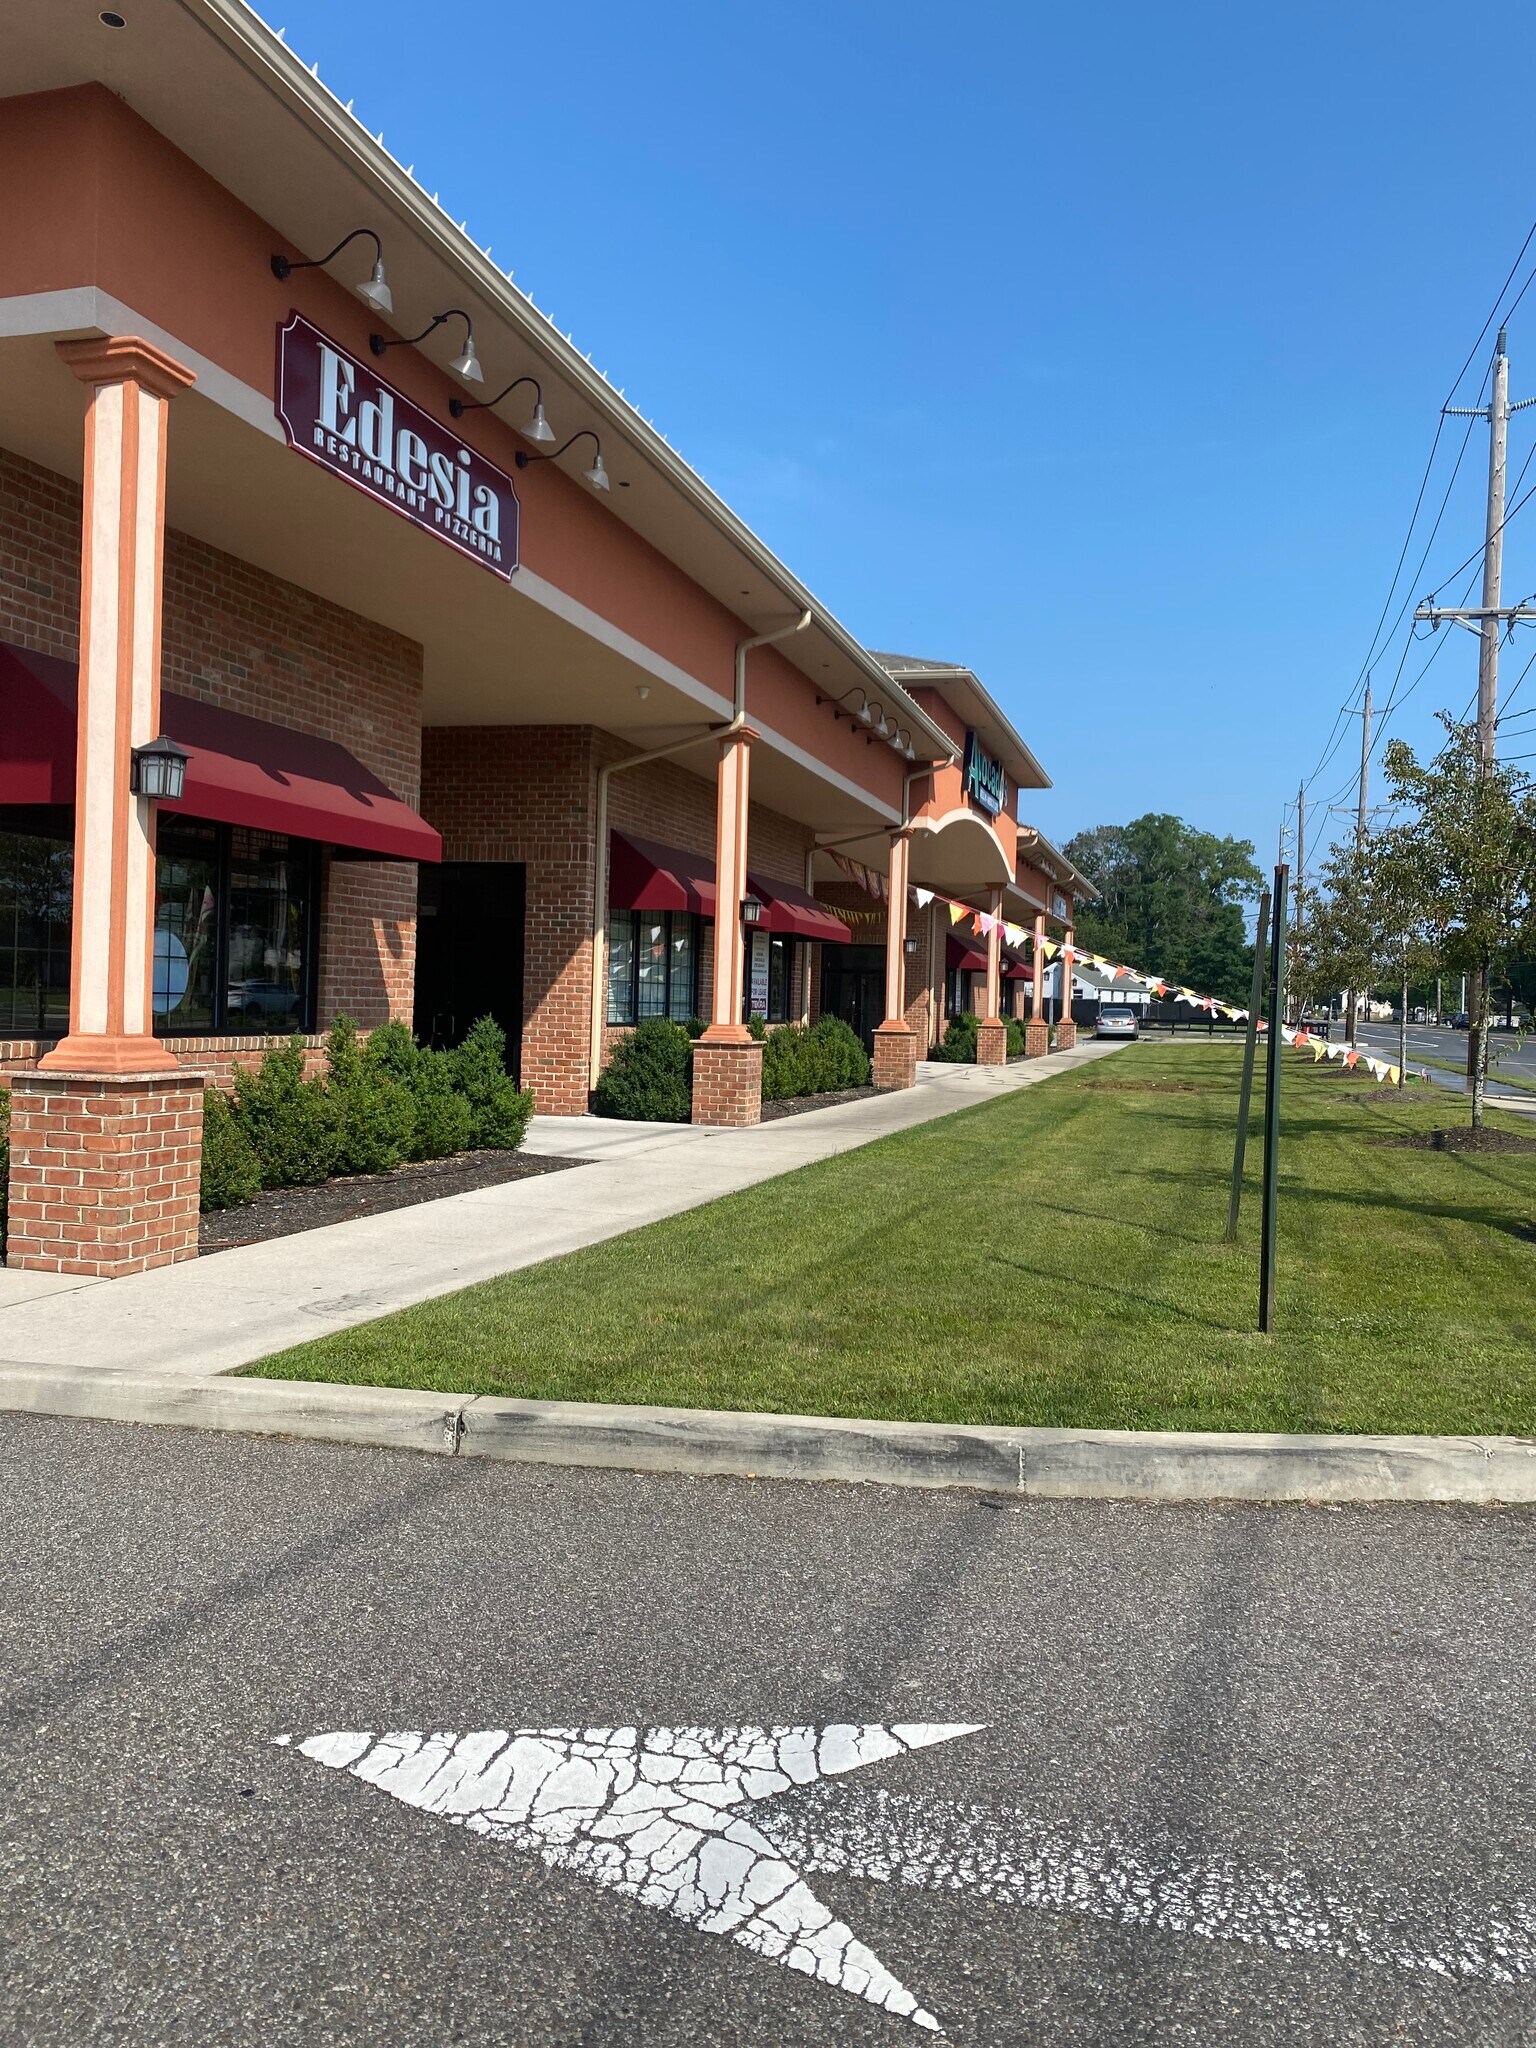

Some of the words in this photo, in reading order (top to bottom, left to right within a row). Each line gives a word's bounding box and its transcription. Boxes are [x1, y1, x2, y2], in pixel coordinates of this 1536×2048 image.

[313, 341, 502, 544] Edesia
[313, 426, 427, 513] RESTAURANT
[435, 507, 502, 562] PIZZERIA
